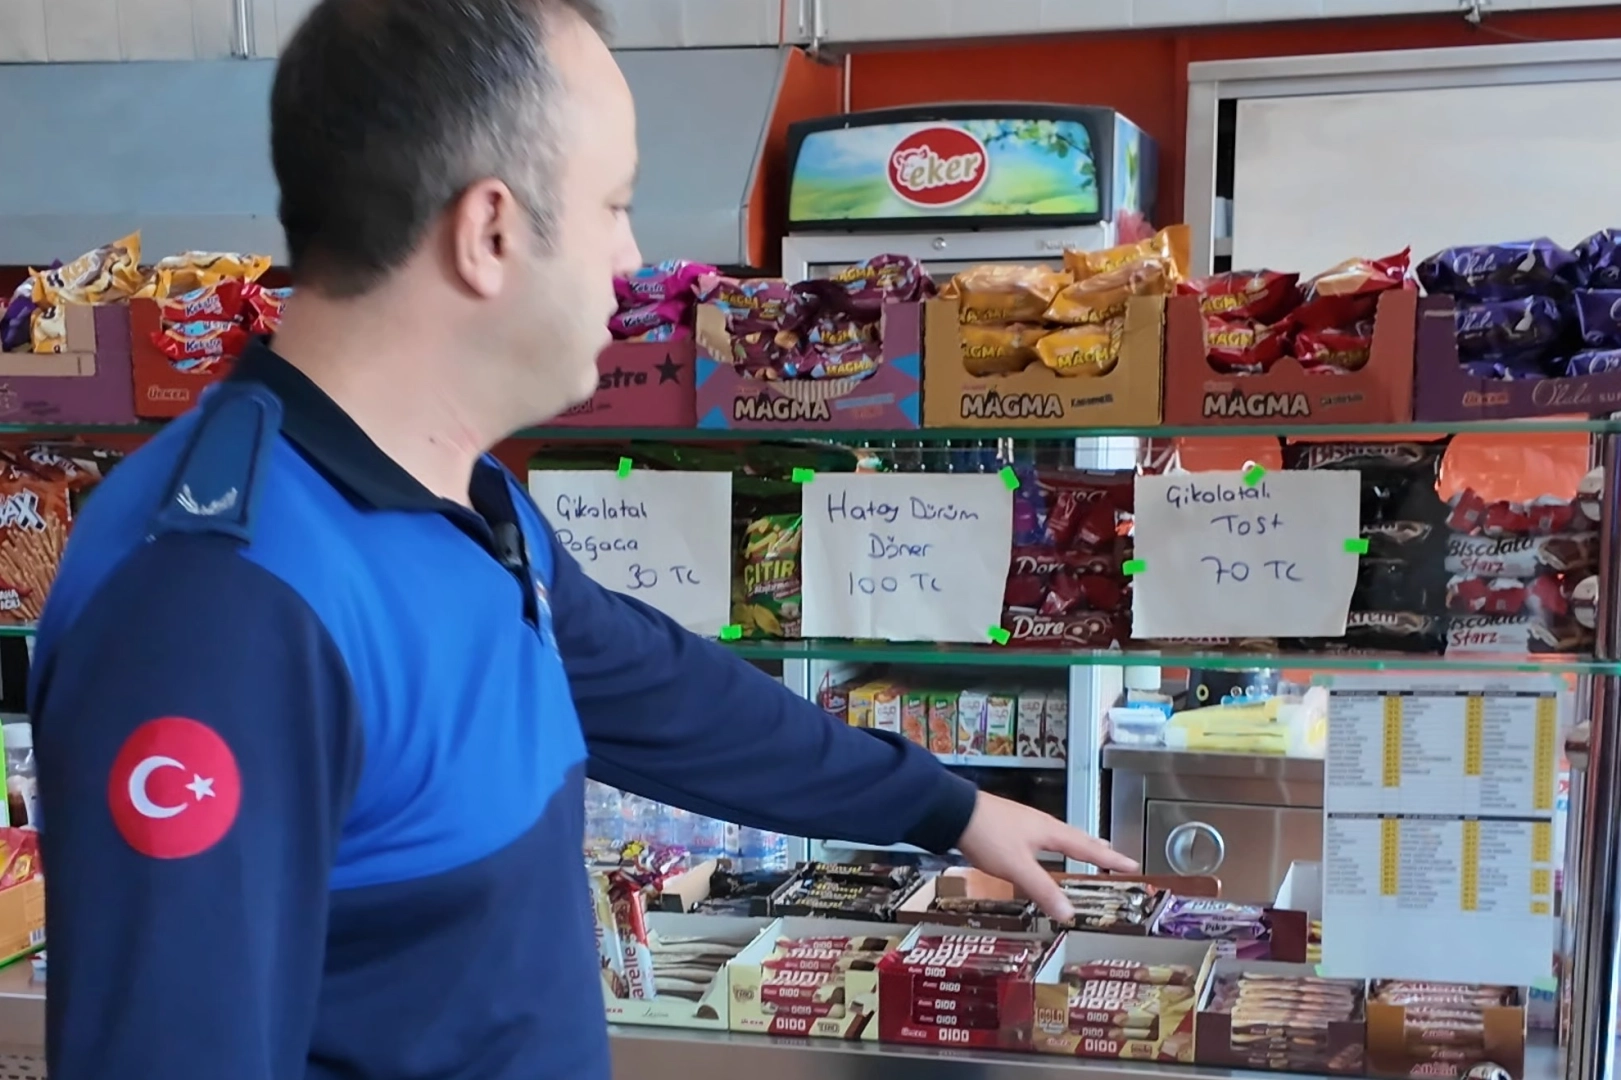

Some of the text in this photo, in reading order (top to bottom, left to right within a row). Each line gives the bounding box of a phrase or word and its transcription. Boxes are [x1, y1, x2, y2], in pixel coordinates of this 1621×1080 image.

[909, 155, 978, 188] eker
[596, 367, 648, 390] stra
[735, 395, 831, 421] MAGMA
[961, 393, 1064, 418] MAGMA
[1204, 391, 1312, 418] MAGMA
[828, 490, 978, 523] Hatay Dürüm
[869, 533, 930, 559] Döner
[626, 563, 657, 590] 30
[1200, 556, 1250, 584] 70
[1460, 558, 1505, 572] Starz
[849, 572, 898, 595] 100
[1012, 615, 1065, 639] Dore
[1452, 630, 1498, 646] Starz
[1204, 922, 1229, 933] Piko
[776, 1016, 807, 1031] DIDO
[1037, 1009, 1065, 1023] GOLD
[938, 1027, 970, 1043] DIDO
[1084, 1038, 1118, 1053] DIDO
